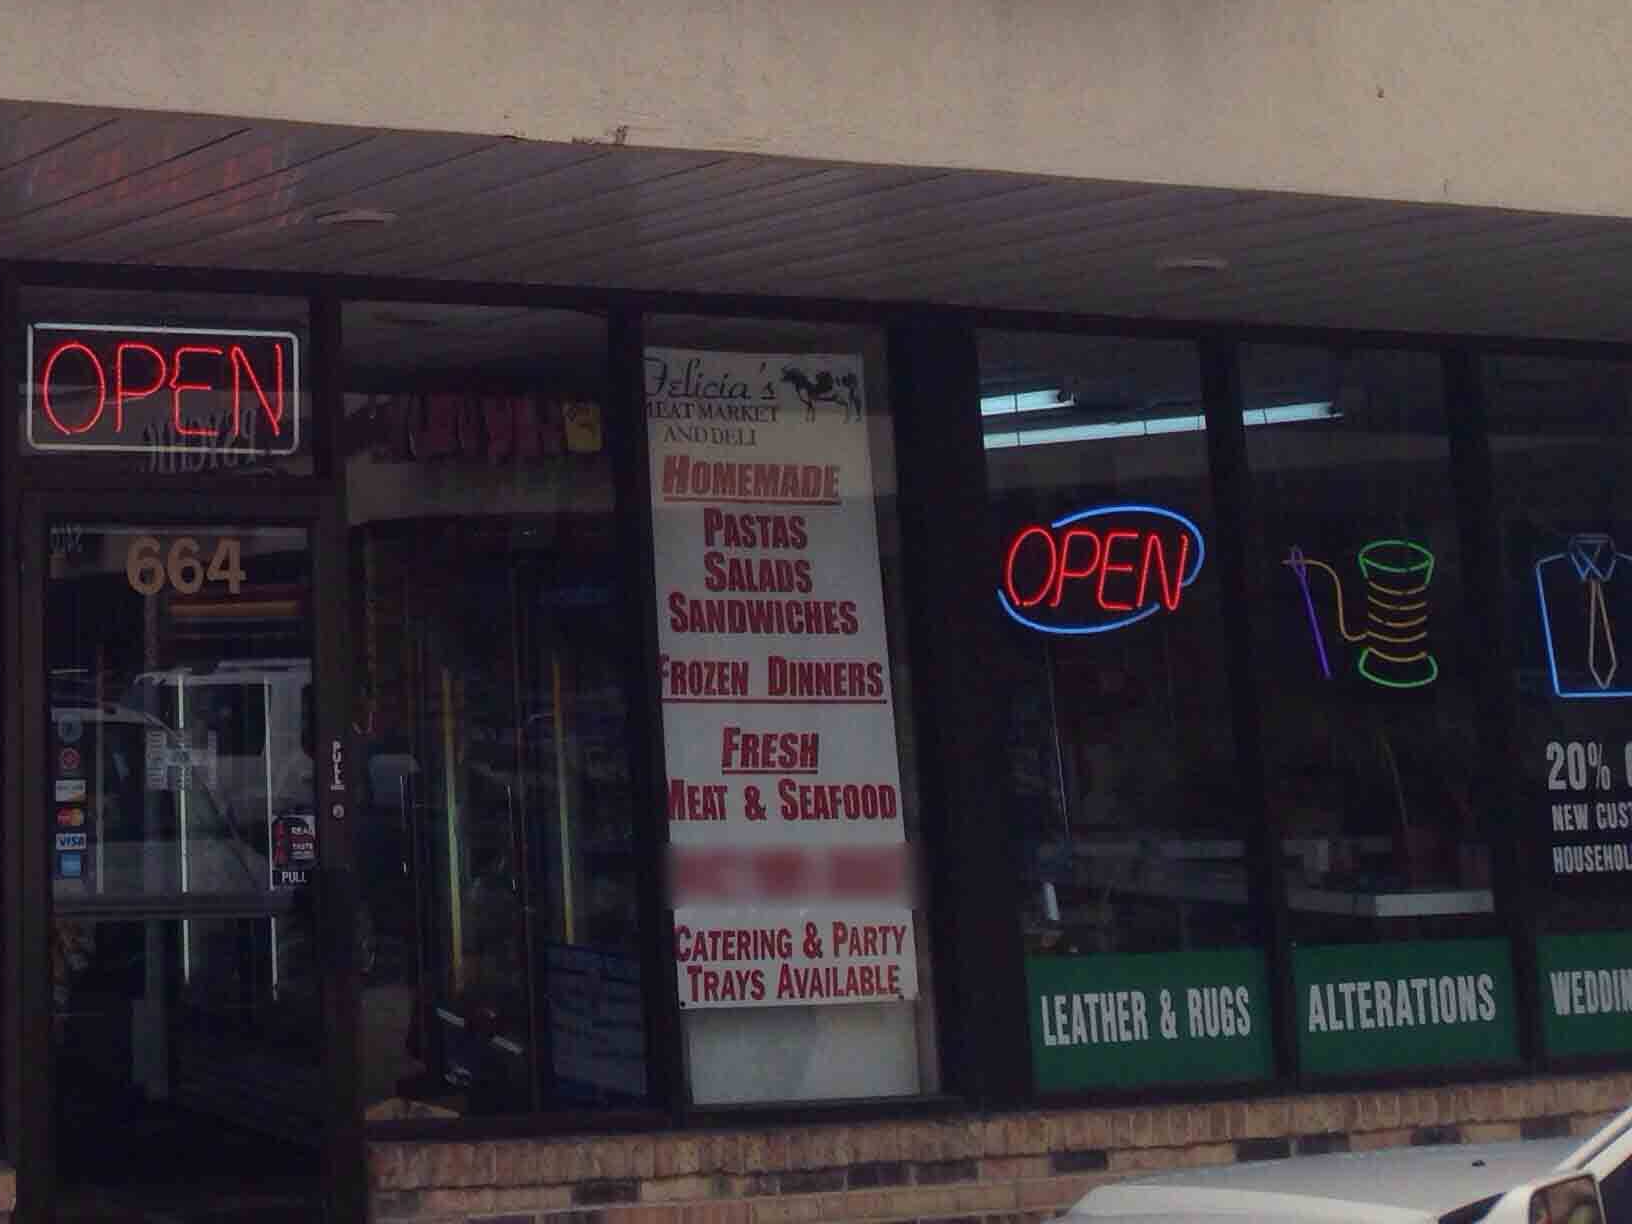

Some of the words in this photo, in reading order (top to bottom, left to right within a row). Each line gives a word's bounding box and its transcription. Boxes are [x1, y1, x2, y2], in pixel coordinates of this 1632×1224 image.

[42, 342, 283, 436] OPEN
[697, 404, 781, 424] MARKET
[664, 426, 709, 445] AND
[711, 428, 757, 446] DELI
[662, 455, 841, 499] HOMEMADE
[704, 508, 808, 550] PASTAS
[125, 535, 247, 596] 664
[704, 552, 813, 593] SALADS
[1008, 526, 1188, 611] OPEN
[669, 592, 858, 635] SANDWICHES
[768, 656, 883, 698] DINNERS
[722, 727, 819, 769] FRESH
[1546, 741, 1611, 791] 20%
[744, 784, 768, 821] &
[778, 779, 897, 821] SEAFOOD
[1552, 802, 1588, 832] NEW
[675, 923, 792, 961] CATERING
[803, 922, 823, 958] &
[833, 921, 907, 958] PARTY
[688, 964, 765, 1001] TRAYS
[777, 963, 900, 999] AVAILABLE
[1041, 990, 1148, 1046] LEATHER
[1160, 989, 1177, 1038] &
[1190, 985, 1251, 1038] RUGS
[1308, 975, 1496, 1032] ALTERATIONS
